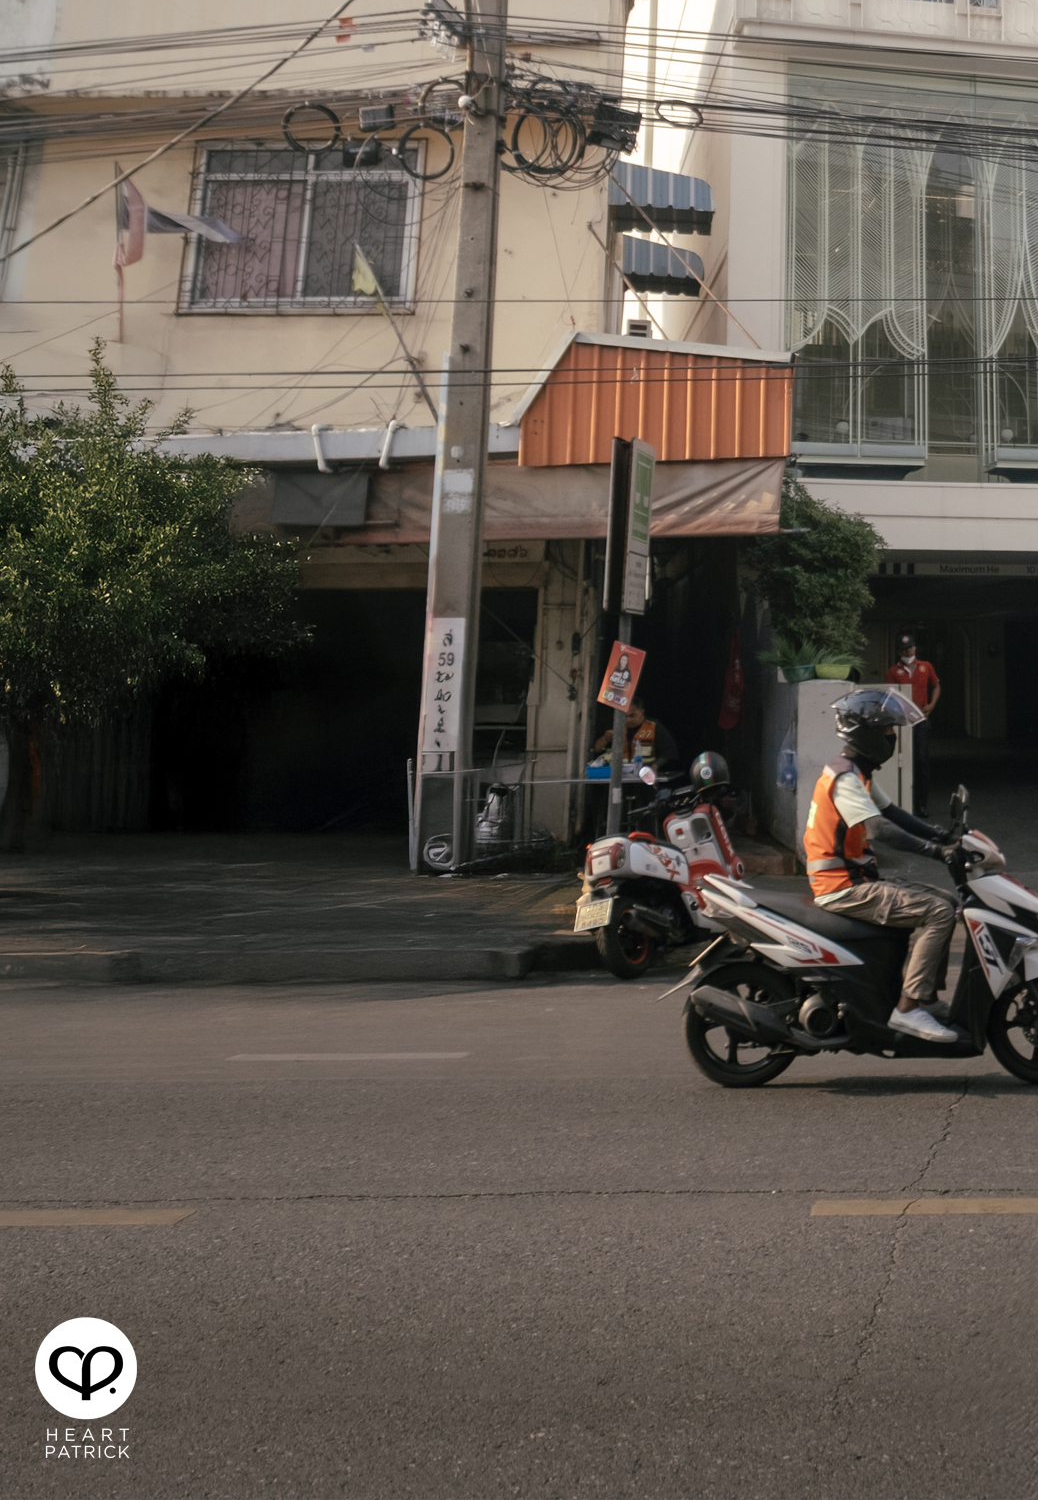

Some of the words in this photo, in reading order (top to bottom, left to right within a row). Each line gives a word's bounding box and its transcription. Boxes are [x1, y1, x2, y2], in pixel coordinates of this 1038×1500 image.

[939, 564, 985, 574] Maximum
[438, 652, 455, 667] 59
[640, 730, 652, 739] 27
